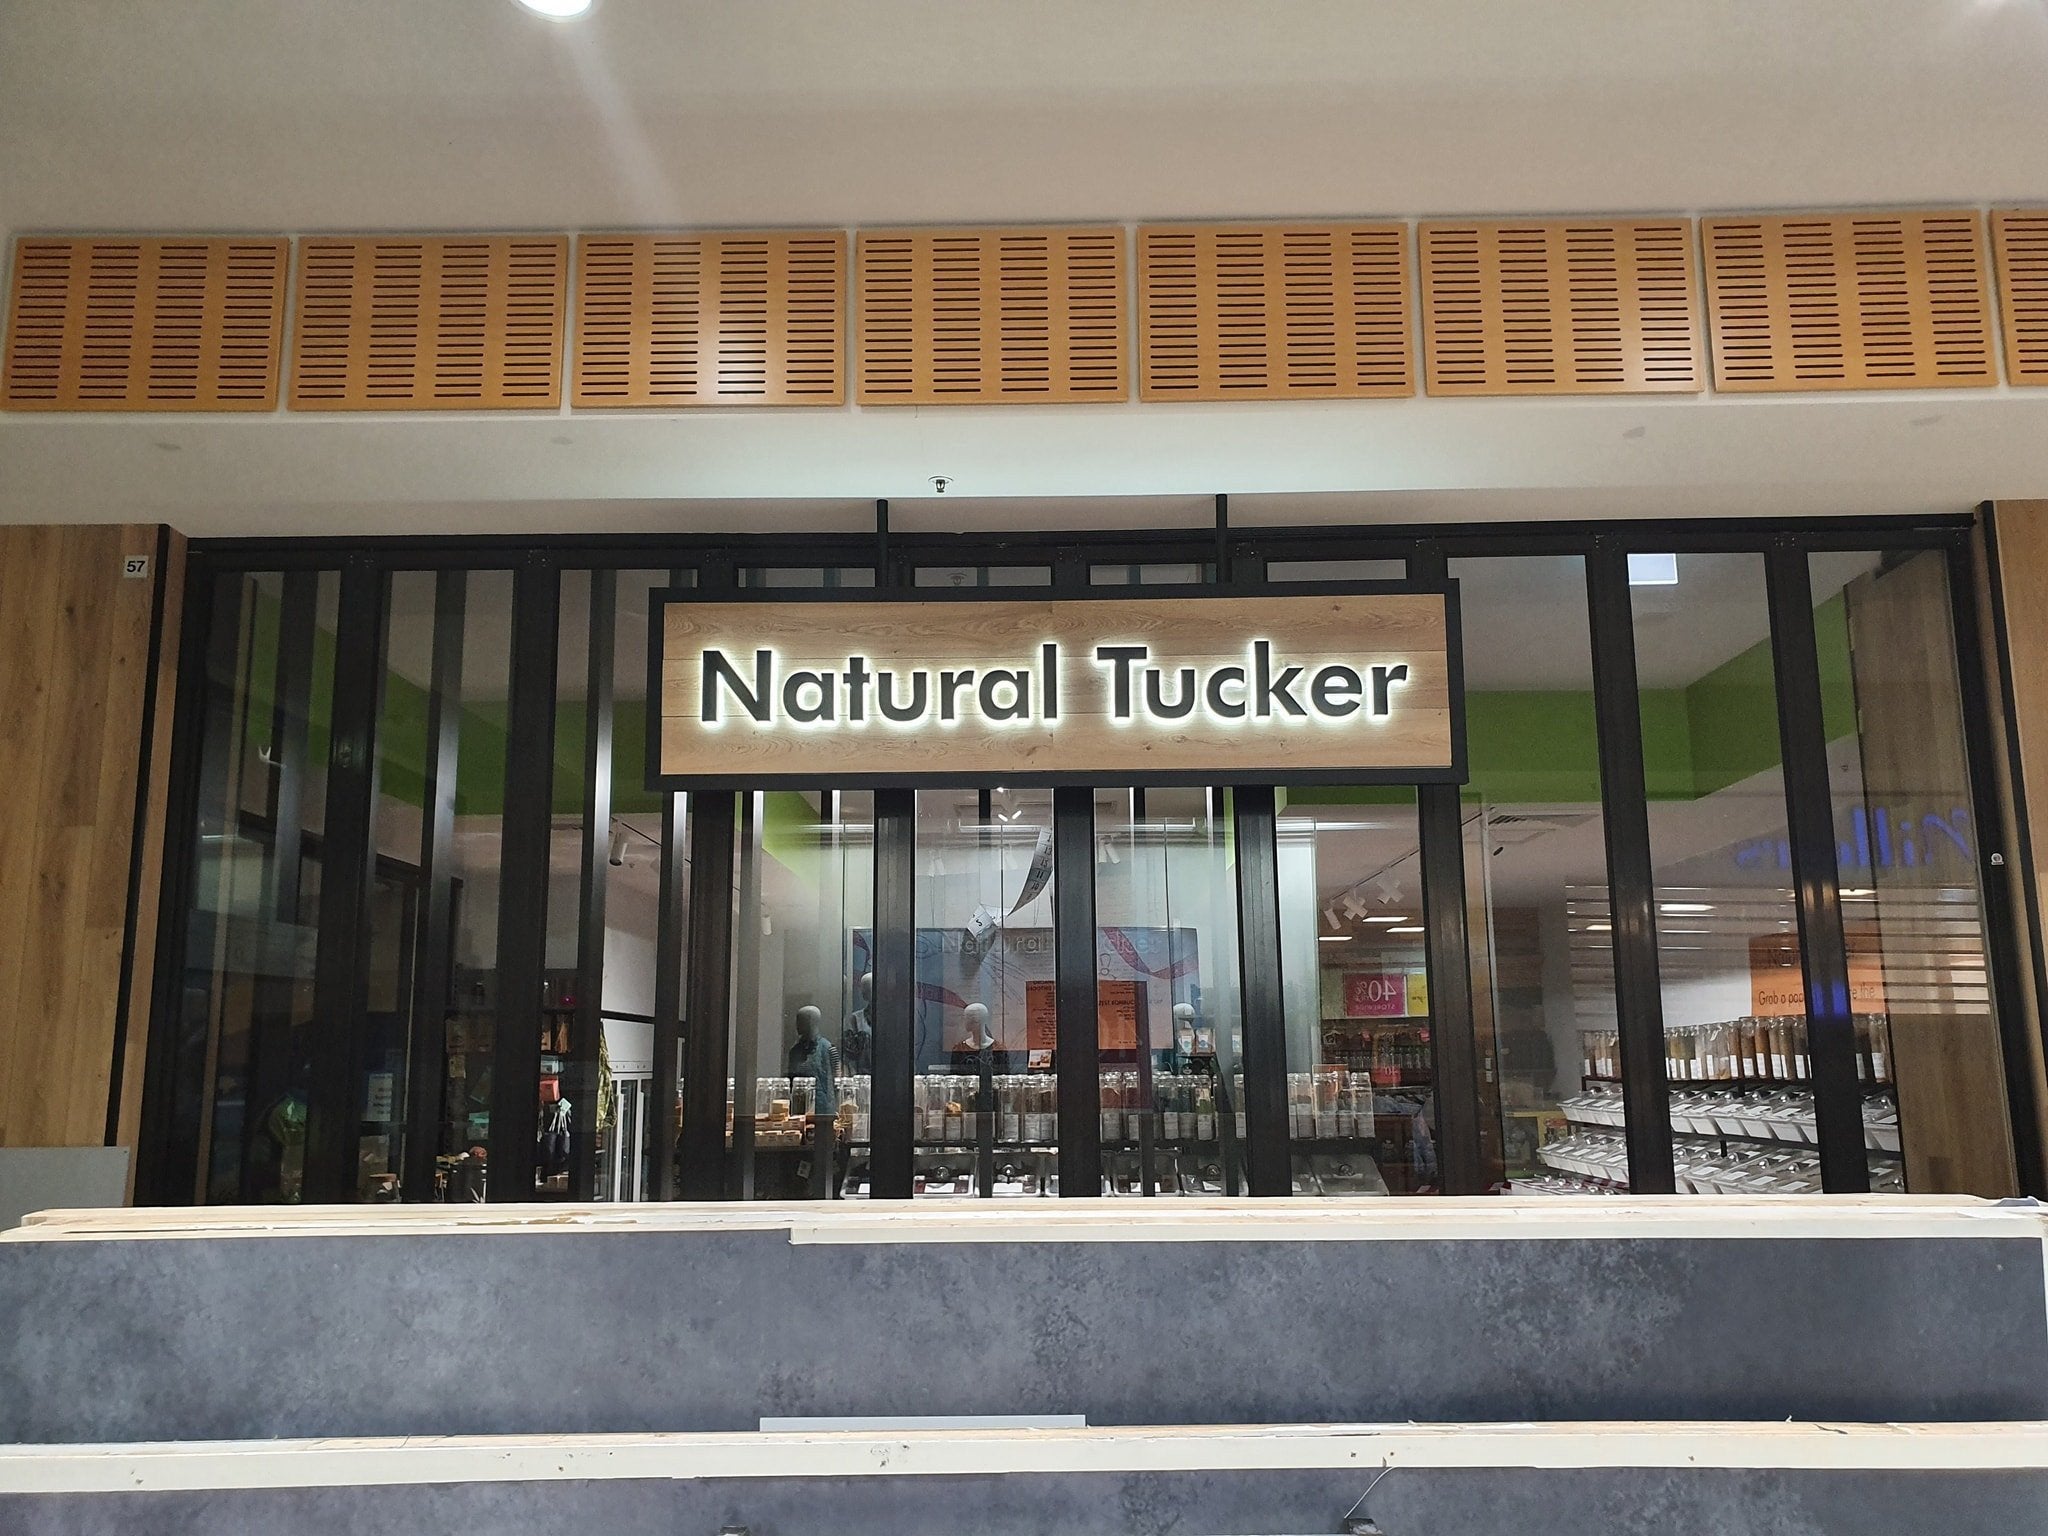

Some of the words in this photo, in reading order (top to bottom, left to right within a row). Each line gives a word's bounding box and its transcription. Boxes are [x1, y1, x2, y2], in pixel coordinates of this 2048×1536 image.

[127, 560, 145, 573] 57
[701, 643, 1057, 723] Natural
[1096, 640, 1408, 719] Tucker
